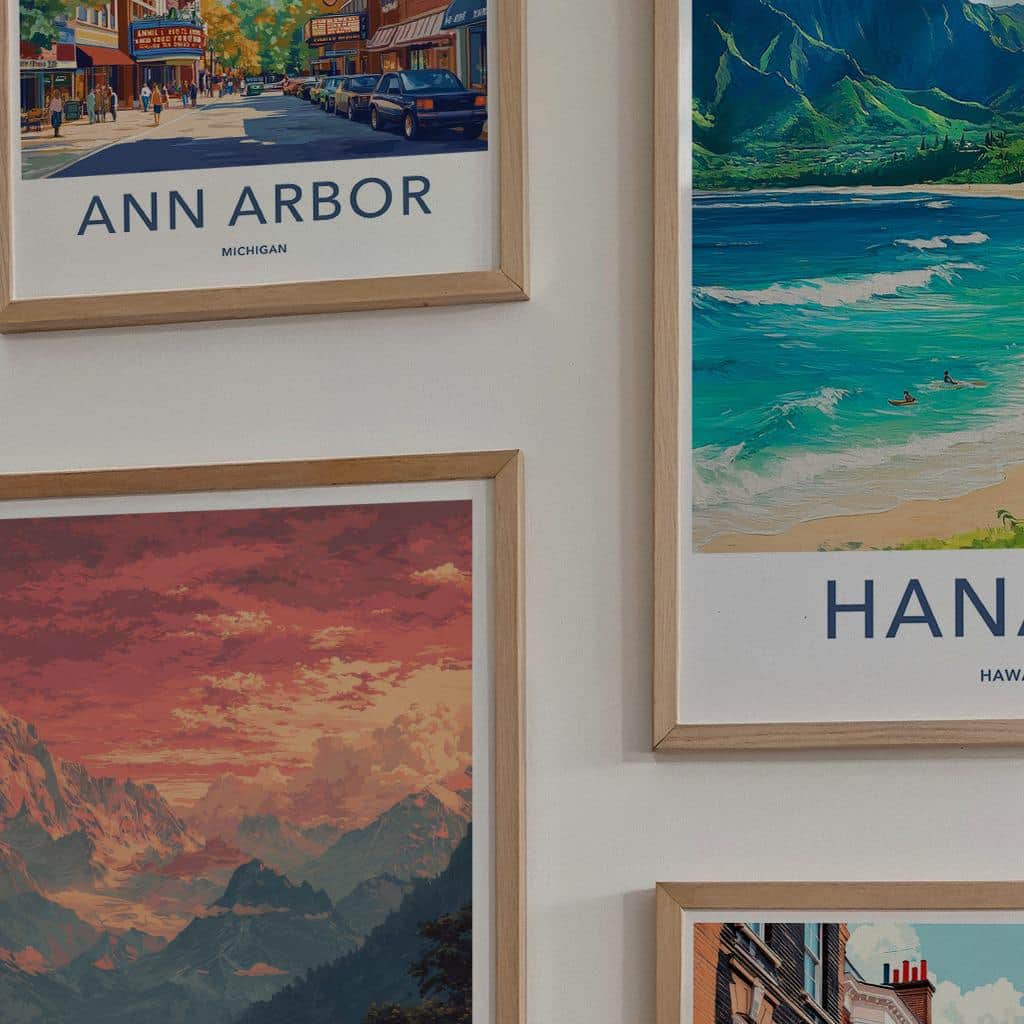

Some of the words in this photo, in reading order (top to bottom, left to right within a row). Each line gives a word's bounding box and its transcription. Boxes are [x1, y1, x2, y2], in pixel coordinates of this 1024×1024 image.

[77, 189, 205, 236] ANN
[228, 175, 432, 227] ARBOR
[221, 243, 288, 257] MICHIGAN
[826, 577, 1024, 640] HAN
[980, 668, 1024, 683] HAW
